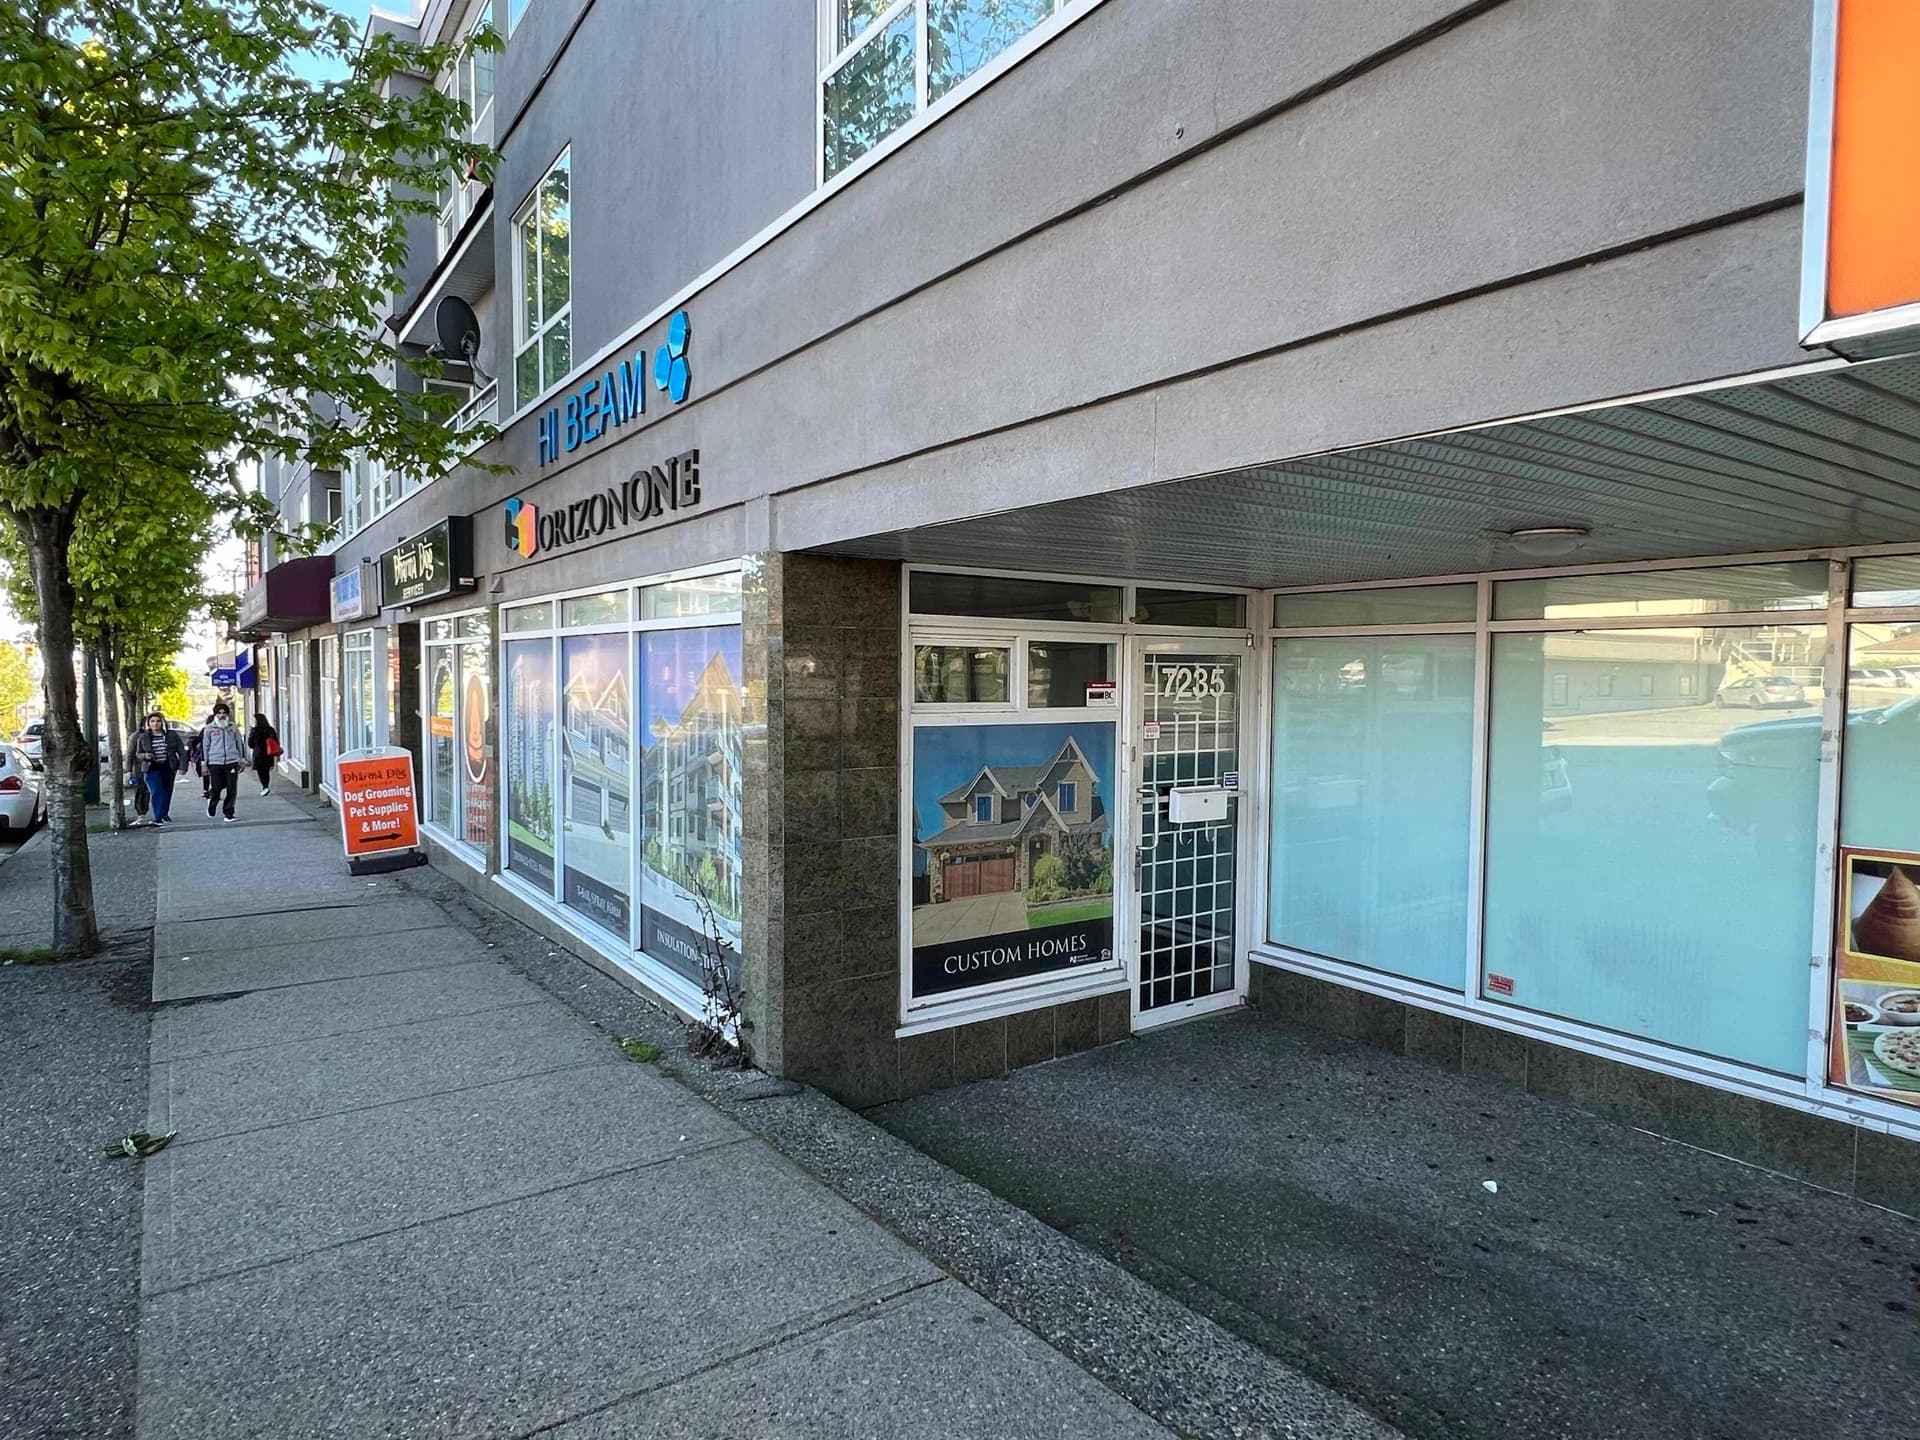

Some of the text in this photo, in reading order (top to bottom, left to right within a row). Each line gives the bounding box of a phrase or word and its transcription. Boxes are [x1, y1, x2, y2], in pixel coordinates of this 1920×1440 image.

[536, 350, 646, 468] HI BEAM
[1162, 667, 1225, 698] 7235
[344, 785, 412, 803] Dog Grooming
[350, 801, 409, 818] Pet Supplies
[361, 817, 401, 833] & More!
[944, 933, 1087, 975] CUSTOM HOMES
